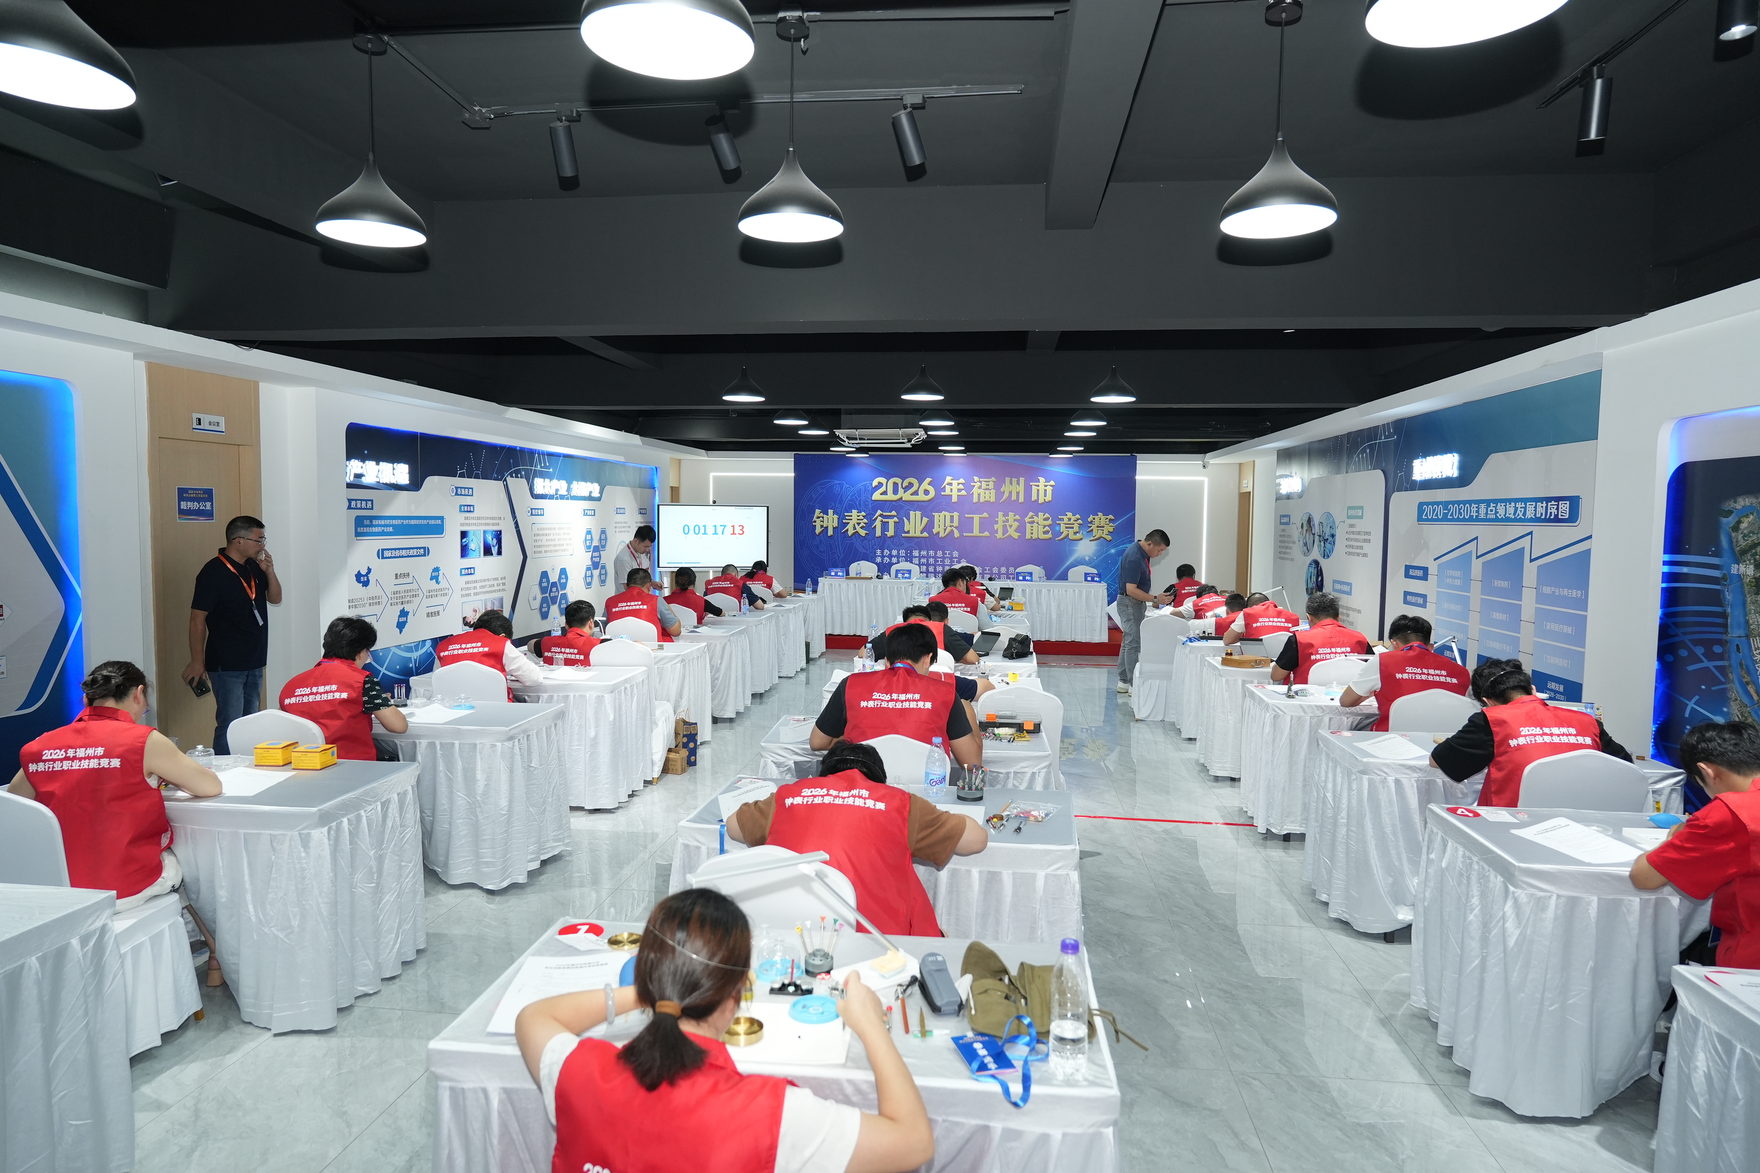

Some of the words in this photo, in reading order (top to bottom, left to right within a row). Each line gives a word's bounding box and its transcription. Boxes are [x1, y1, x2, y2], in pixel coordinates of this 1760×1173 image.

[871, 476, 1055, 504] 2026年福州市
[1422, 501, 1570, 519] 2020-2030年重点领域发展时序图
[682, 524, 690, 535] 0
[693, 524, 708, 535] 01
[712, 524, 727, 535] 17
[730, 524, 745, 535] 13
[812, 508, 1116, 542] 钟表行业职工技能竞赛
[28, 758, 121, 773] 钟表行业职业技能竞赛
